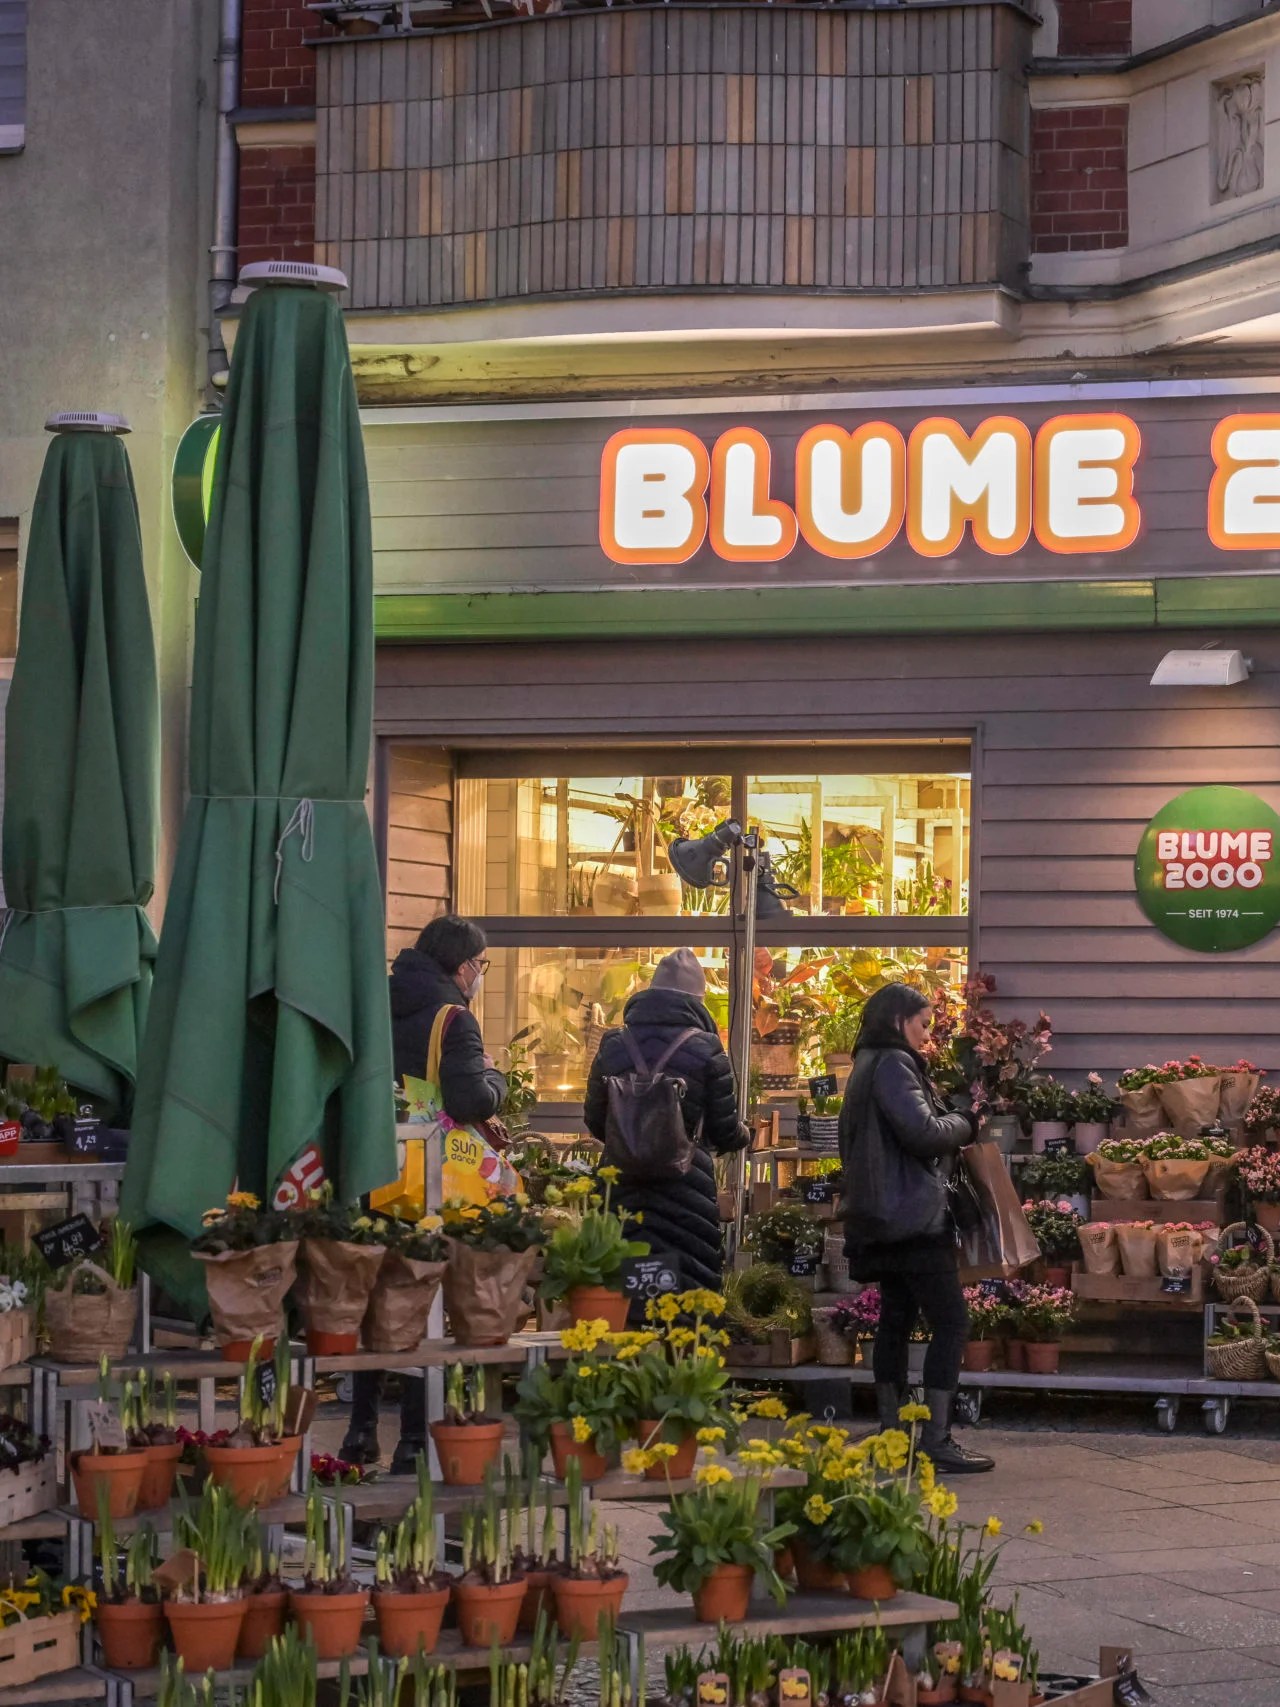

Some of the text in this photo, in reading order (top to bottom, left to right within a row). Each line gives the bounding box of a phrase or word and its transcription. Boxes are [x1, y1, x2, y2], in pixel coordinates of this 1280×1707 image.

[601, 412, 1141, 565] BLUME
[1157, 831, 1272, 860] BLUME
[1164, 861, 1263, 889] 2000
[1188, 908, 1239, 919] SEIT 1974
[451, 1138, 478, 1158] sun
[451, 1153, 477, 1166] dance
